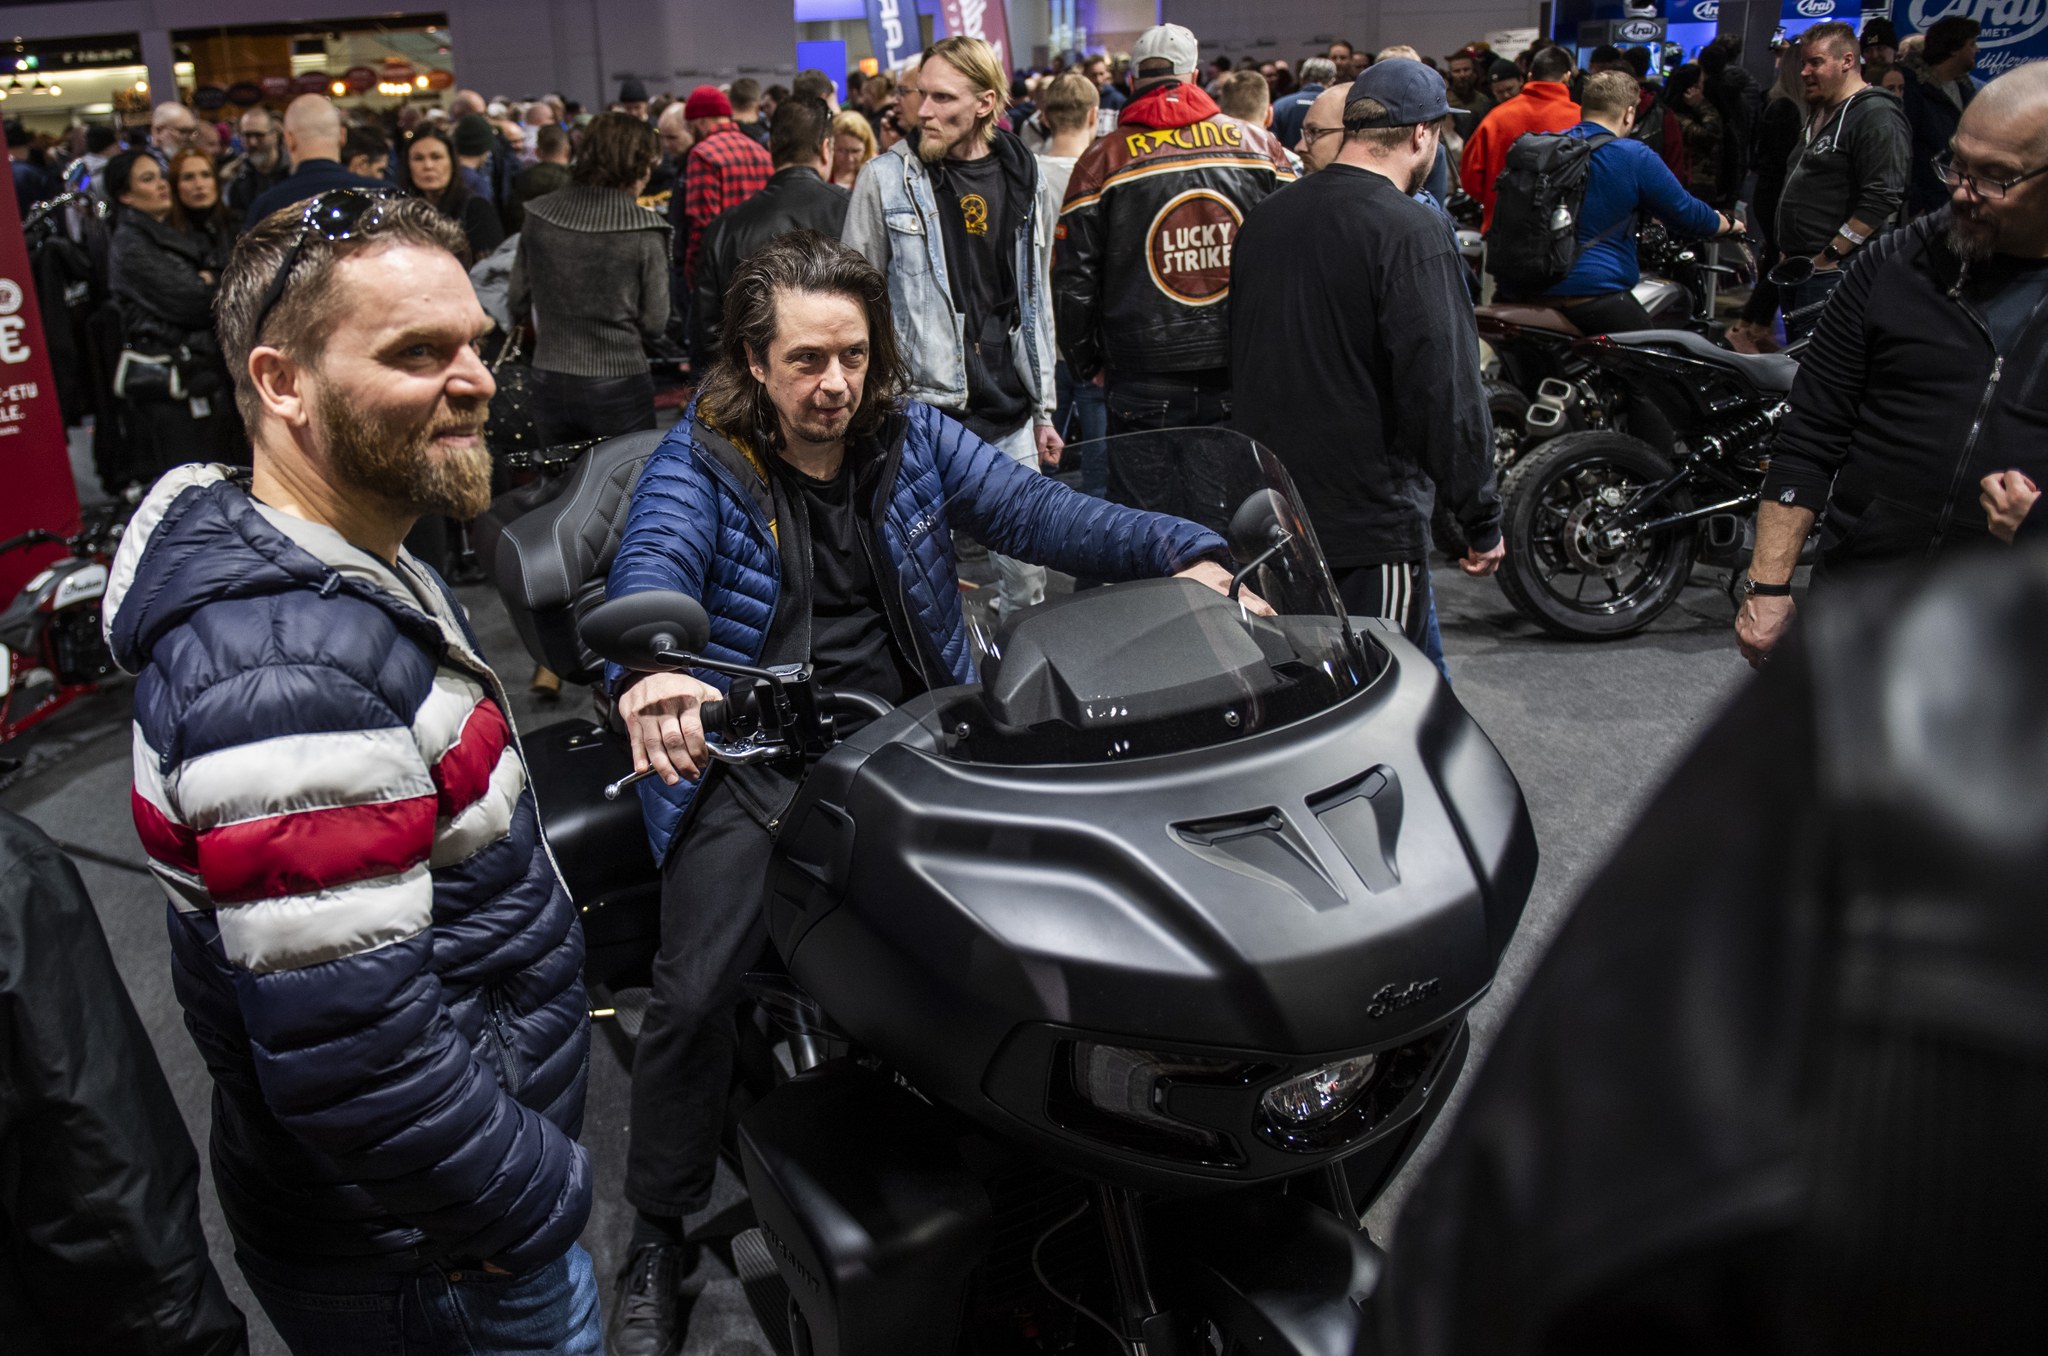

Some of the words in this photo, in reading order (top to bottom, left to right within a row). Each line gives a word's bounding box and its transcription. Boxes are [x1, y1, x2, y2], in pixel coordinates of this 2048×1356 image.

[1977, 27, 2010, 38] MET
[1162, 222, 1232, 252] LUCKY
[1162, 244, 1232, 274] STRIKE
[1366, 977, 1440, 1018] Indian
